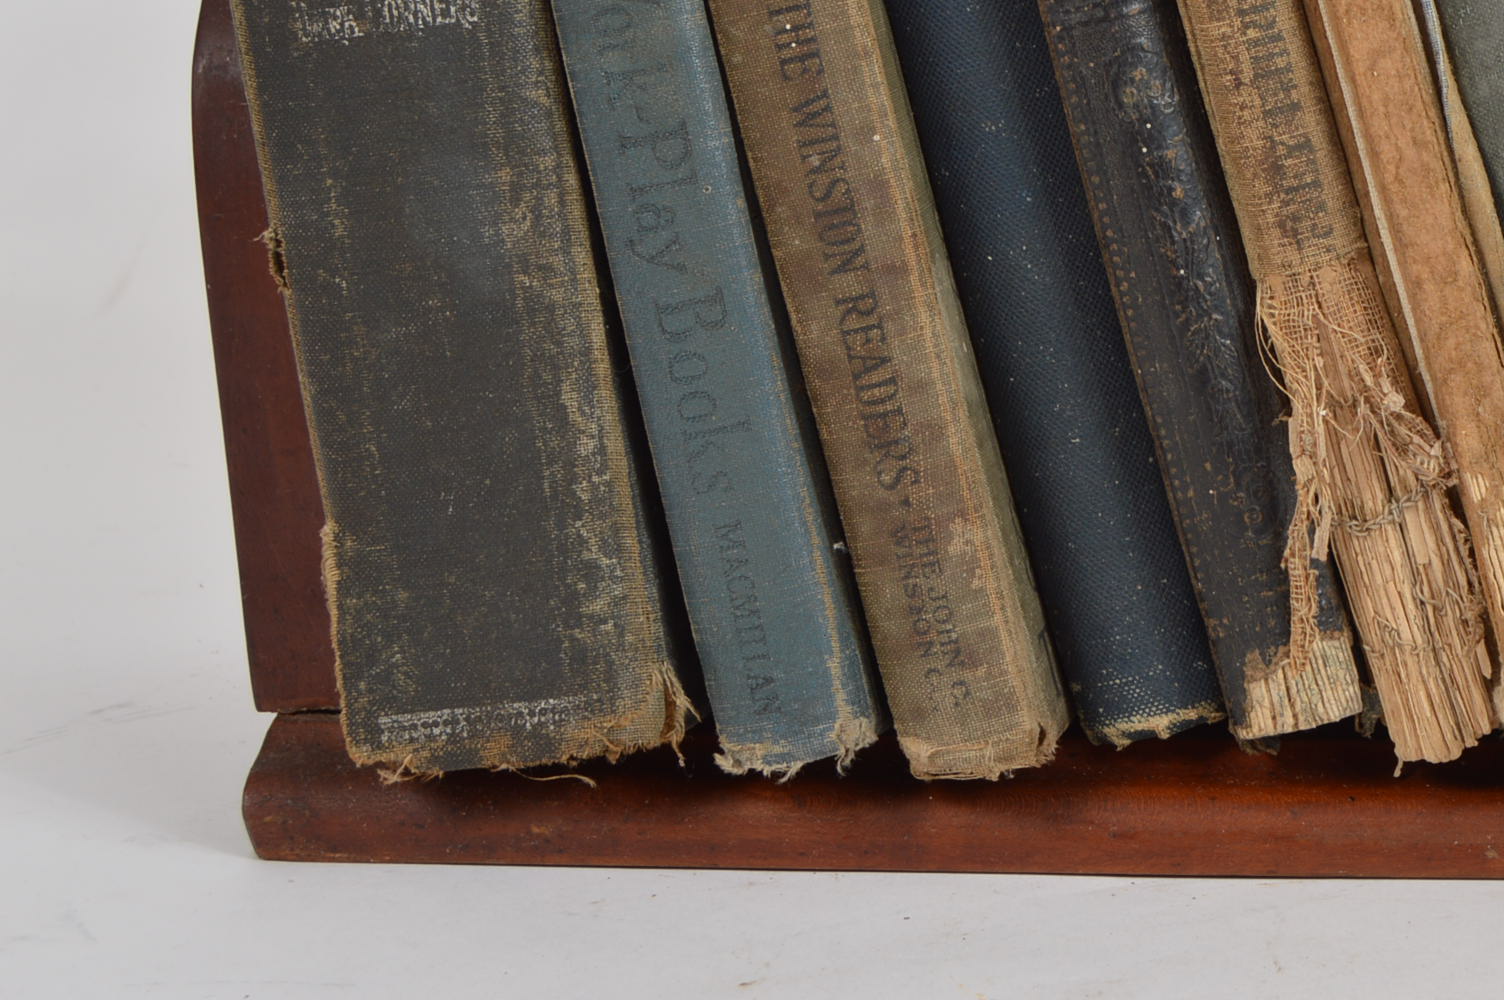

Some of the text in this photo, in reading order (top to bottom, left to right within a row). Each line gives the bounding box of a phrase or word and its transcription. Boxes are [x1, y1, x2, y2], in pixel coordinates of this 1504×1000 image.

[790, 92, 867, 277] WINSTON
[836, 288, 921, 494] READERS
[655, 286, 752, 496] Books
[713, 520, 783, 719] MACMILLAN
[909, 515, 943, 580] THE
[889, 522, 936, 660] WINSTON
[925, 584, 964, 670] JOHN
